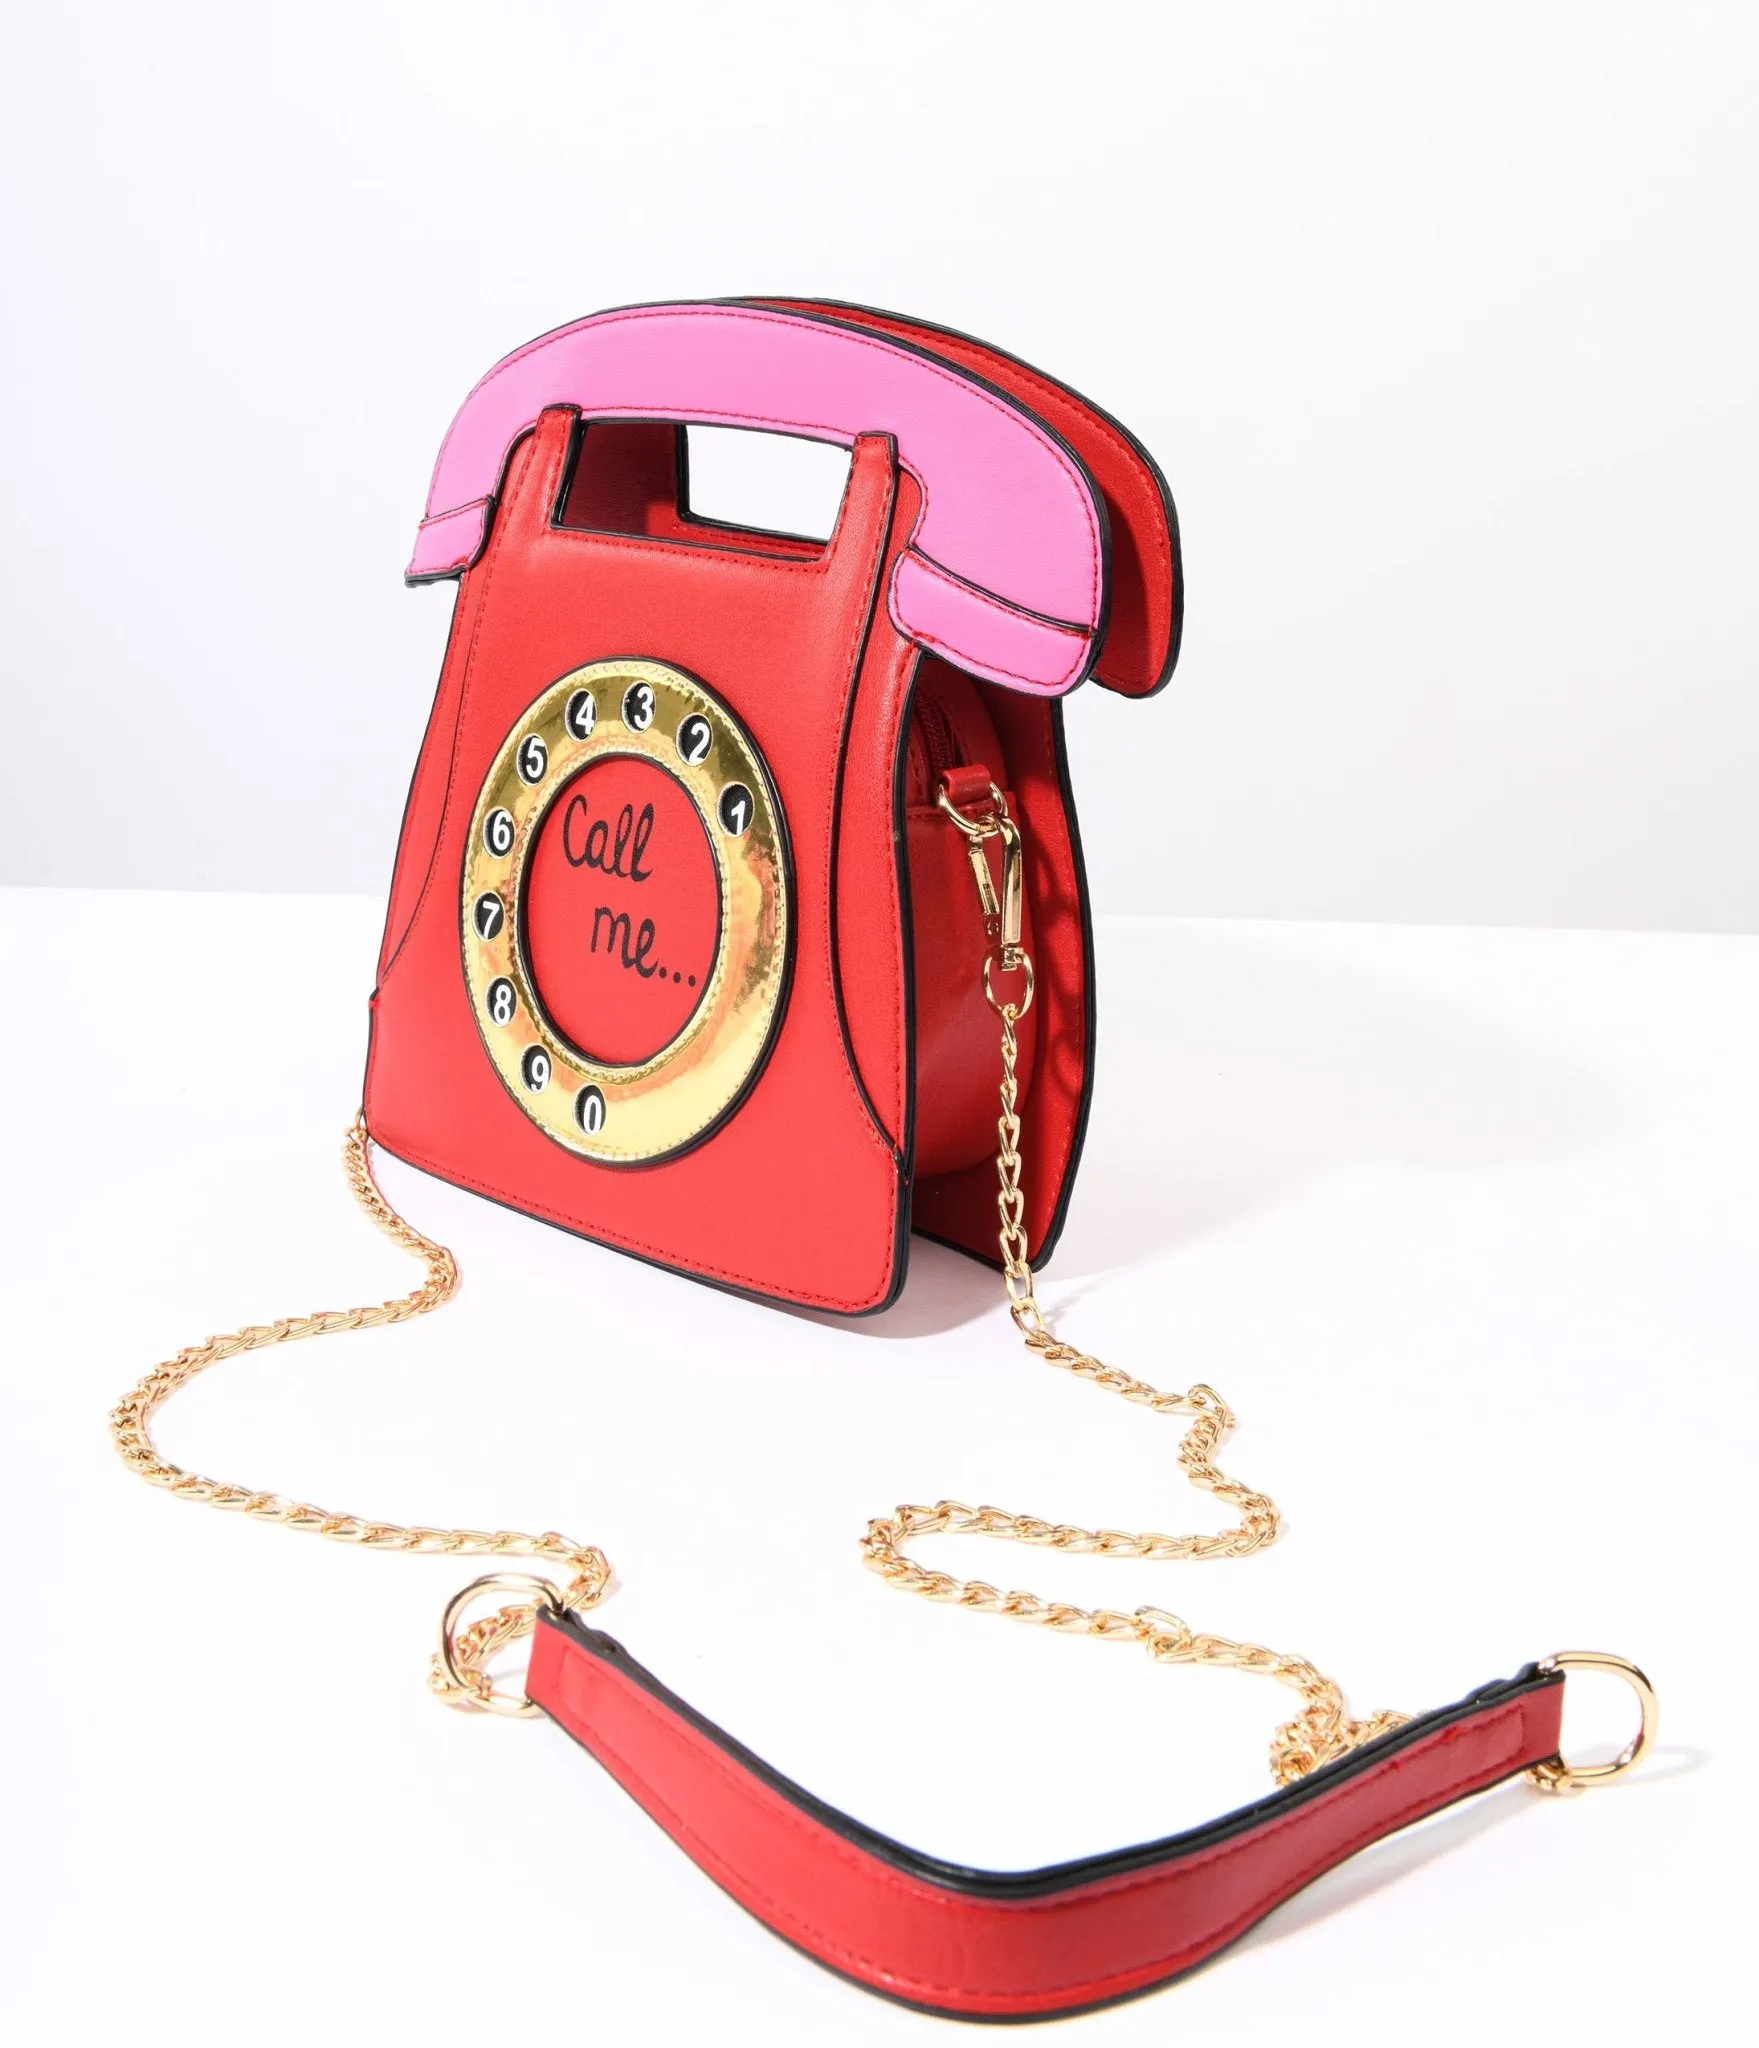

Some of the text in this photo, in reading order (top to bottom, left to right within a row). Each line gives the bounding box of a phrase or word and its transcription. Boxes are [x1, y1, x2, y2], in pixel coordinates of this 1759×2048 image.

[576, 691, 595, 735] 4
[635, 686, 654, 728] 3
[526, 740, 545, 778] 5
[690, 722, 710, 763] 2
[493, 811, 511, 848] 6
[731, 800, 746, 832] 1
[562, 794, 655, 882] Call
[483, 900, 500, 938] 7
[590, 907, 697, 987] me...
[494, 983, 512, 1025] 8
[531, 1056, 549, 1091] 9
[583, 1094, 602, 1132] 0
